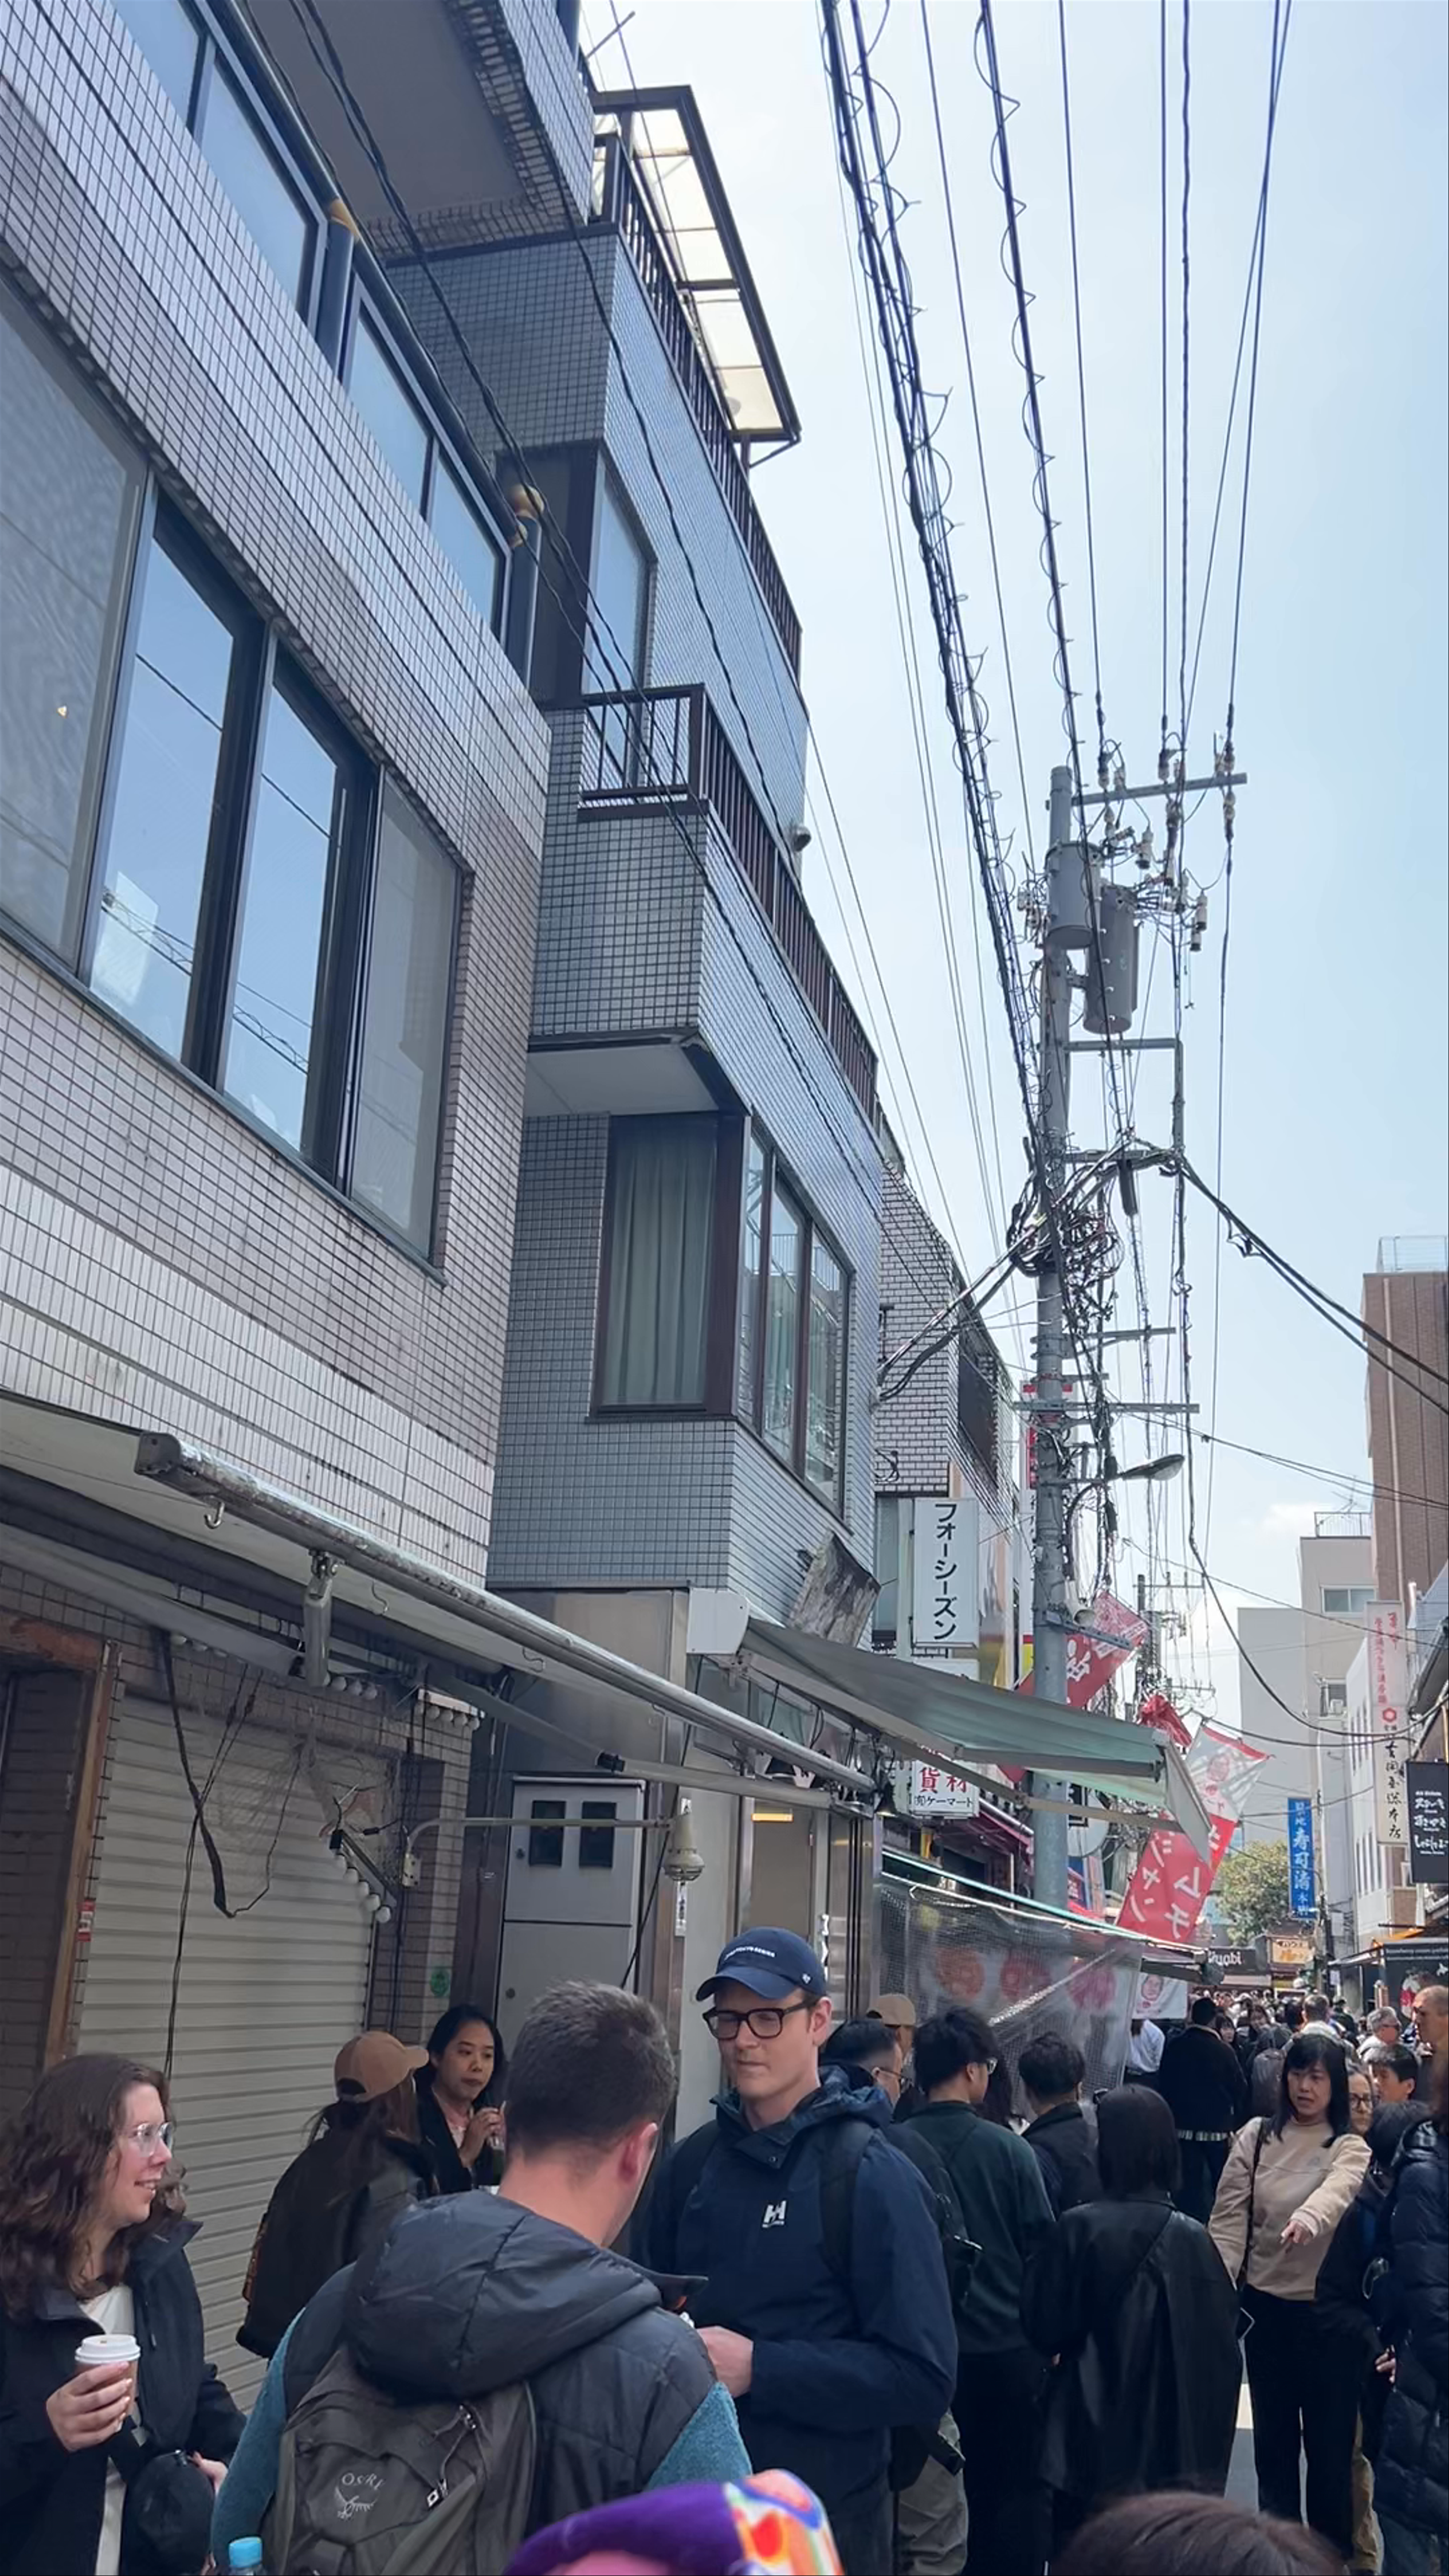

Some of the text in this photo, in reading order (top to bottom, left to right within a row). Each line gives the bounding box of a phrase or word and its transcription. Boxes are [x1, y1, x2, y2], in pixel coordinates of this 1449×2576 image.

[934, 1503, 957, 1640] フォーシーズン
